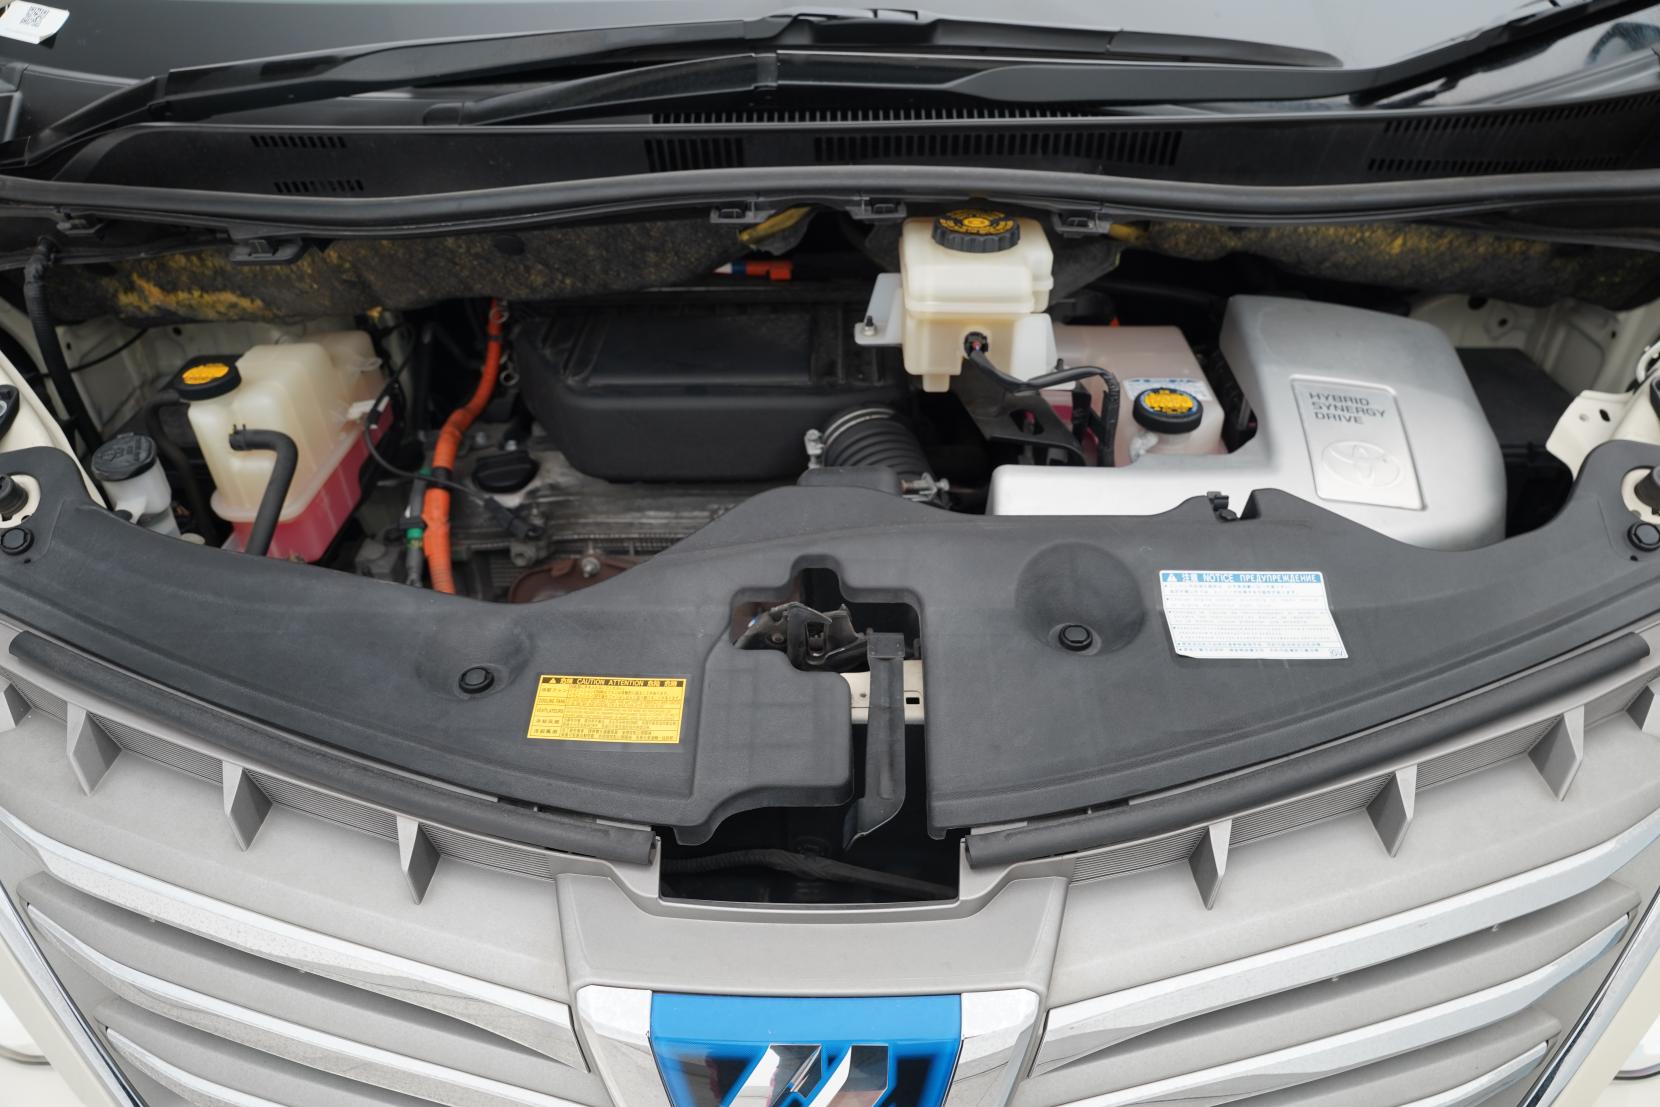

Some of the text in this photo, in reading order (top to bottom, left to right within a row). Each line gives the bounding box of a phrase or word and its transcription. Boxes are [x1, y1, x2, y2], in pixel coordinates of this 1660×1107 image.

[1309, 392, 1370, 406] HYBRID
[1312, 402, 1385, 418] SYNERGY
[1315, 413, 1364, 424] DRIVE
[1203, 573, 1233, 583] NOTICE
[1240, 573, 1317, 583] ПРЕДУПРЕЖДЕНИЕ
[576, 678, 605, 686] CAUTION
[608, 679, 644, 687] ATTENTION
